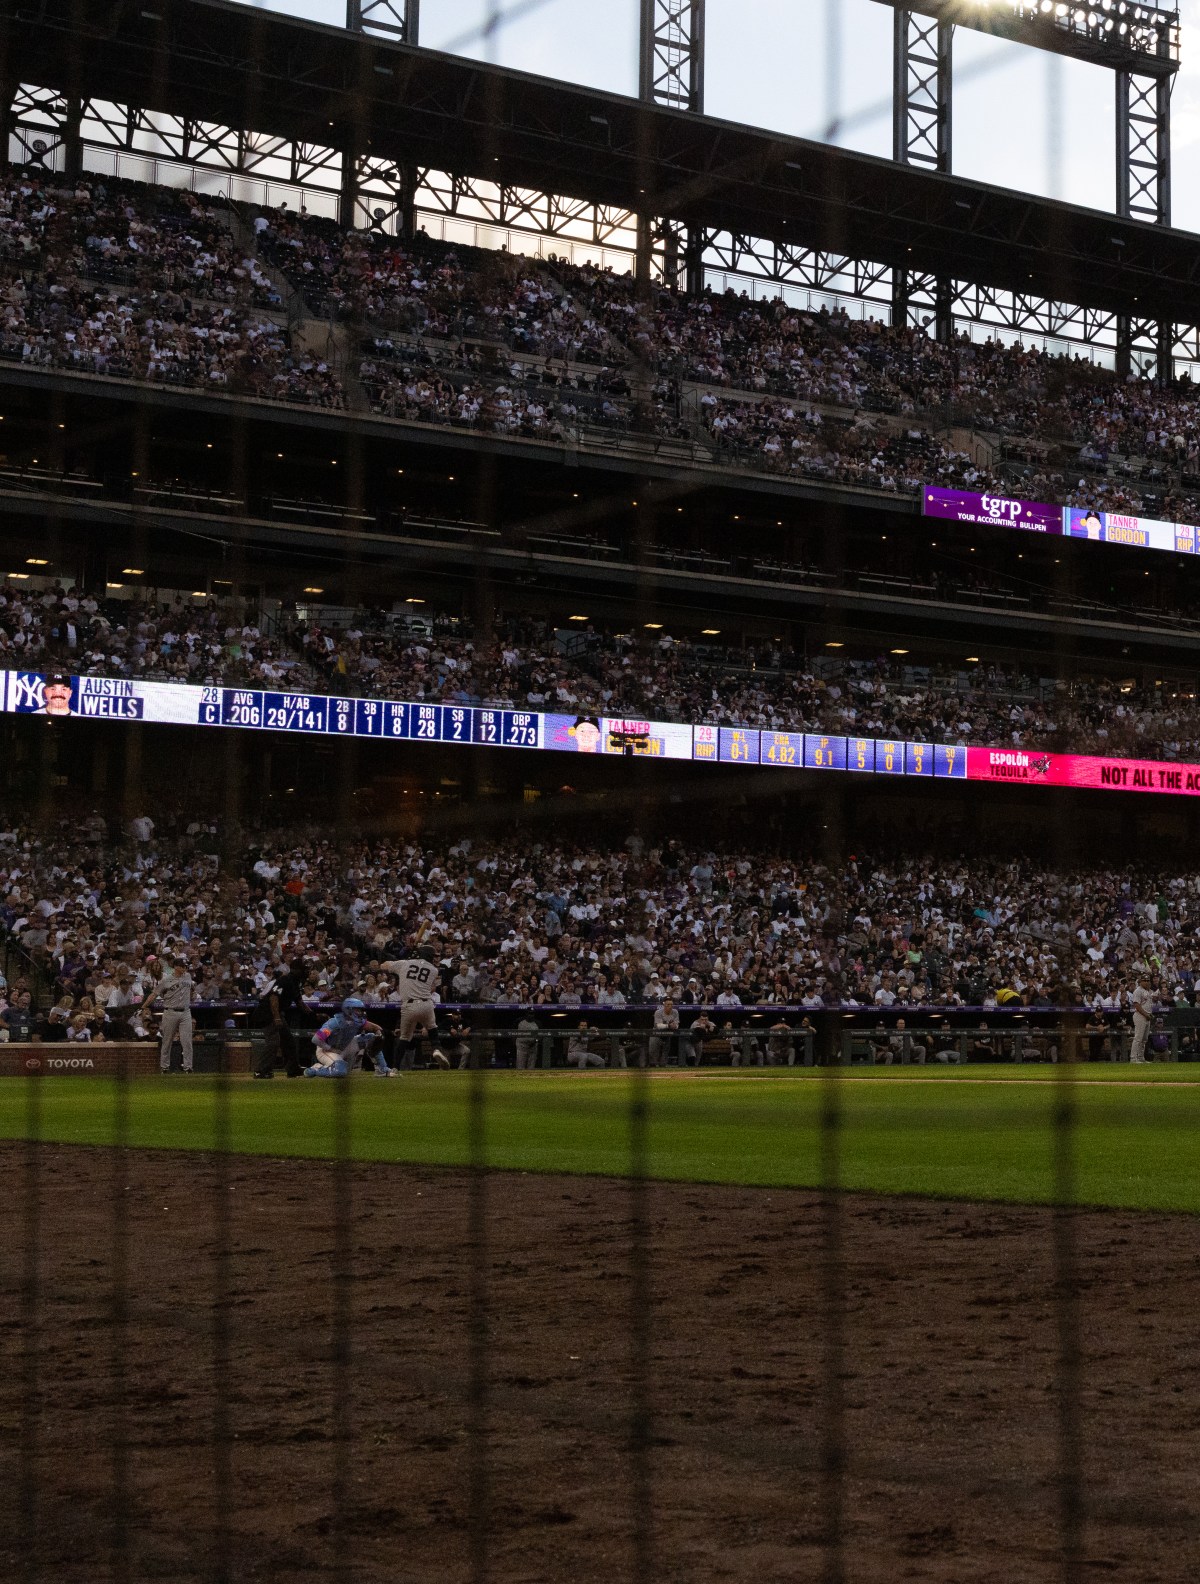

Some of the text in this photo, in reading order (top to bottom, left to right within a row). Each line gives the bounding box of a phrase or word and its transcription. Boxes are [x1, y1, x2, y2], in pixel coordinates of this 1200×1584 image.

[981, 494, 1022, 520] tgrp
[957, 512, 1046, 532] YOUR ACCOUNTING BULLPEN
[1109, 515, 1138, 529] TANNER
[1108, 527, 1146, 544] GORDON
[1180, 525, 1190, 537] 29
[1177, 538, 1192, 551] RHP
[84, 678, 133, 696] AUSTIN
[203, 687, 218, 703] 28
[83, 695, 137, 718] WELLS
[233, 692, 254, 705] AVG
[283, 696, 310, 710] H/AB
[336, 700, 349, 713] 2B
[205, 705, 215, 723] C
[226, 705, 260, 725] .206
[364, 702, 377, 715] 3B
[391, 704, 404, 717] HR
[419, 706, 435, 720] RBI
[452, 710, 464, 722] SB
[267, 708, 322, 729] 29/141
[337, 713, 347, 731] 8
[366, 715, 373, 733] 1
[393, 718, 402, 735] 8
[482, 712, 494, 724] BB
[513, 714, 531, 726] OBP
[417, 720, 435, 737] 28
[453, 722, 462, 739] 2
[480, 724, 497, 742] 12
[506, 726, 536, 745] .273
[699, 727, 712, 740] 29
[696, 743, 715, 757] RHP
[731, 743, 748, 760] 0-1
[767, 745, 795, 763] 4.82
[815, 749, 833, 766] 9.1
[858, 752, 865, 769] 5
[886, 754, 893, 771] 0
[915, 757, 922, 773] 3
[948, 759, 954, 775] 7
[990, 765, 1028, 779] TEQUILA
[1101, 766, 1128, 786] NOT
[1133, 768, 1154, 788] ALL
[1159, 770, 1182, 790] THE
[406, 964, 431, 983] 28
[48, 1059, 94, 1068] TOYOTA
